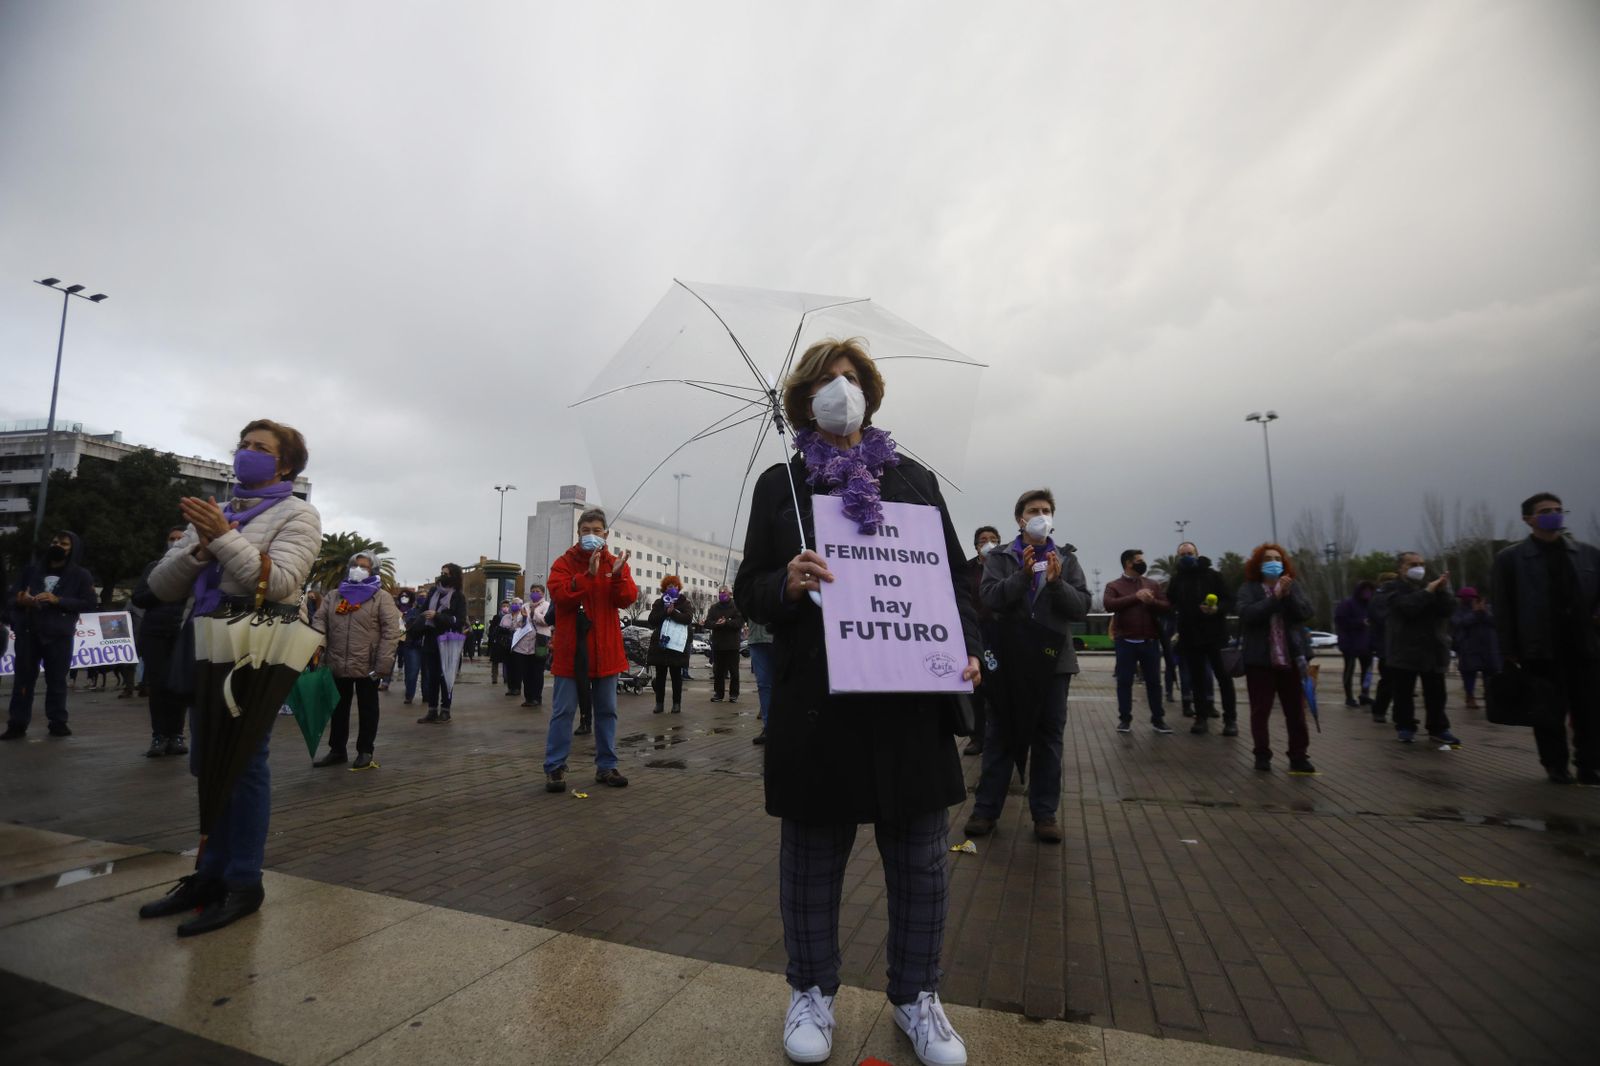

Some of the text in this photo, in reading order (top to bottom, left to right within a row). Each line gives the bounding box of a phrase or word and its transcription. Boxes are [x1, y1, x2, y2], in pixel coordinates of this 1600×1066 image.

[824, 544, 940, 565] FEMINISMO
[874, 573, 902, 587] no
[870, 596, 912, 618] hay
[839, 621, 949, 642] FUTURO
